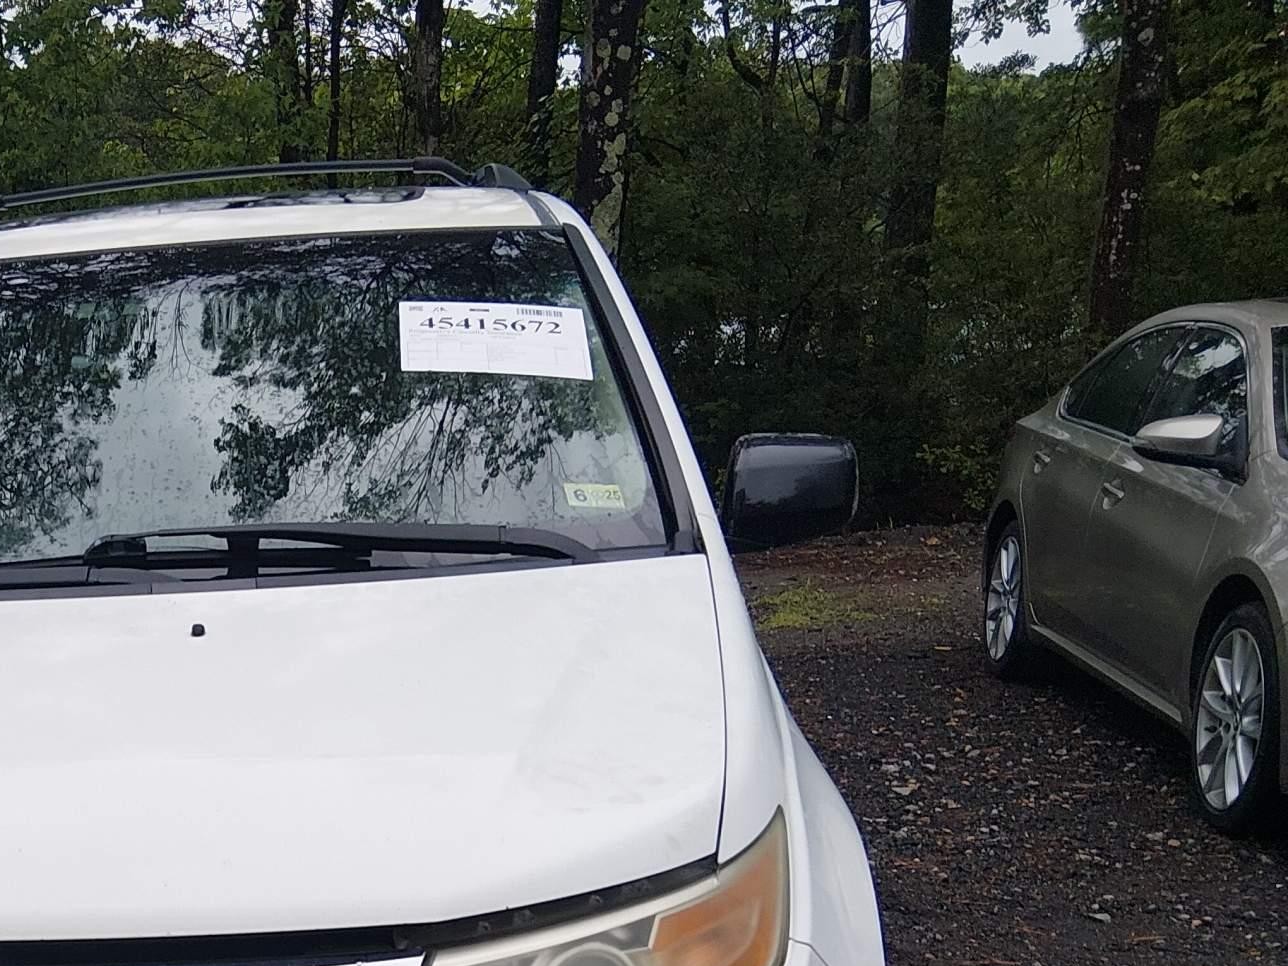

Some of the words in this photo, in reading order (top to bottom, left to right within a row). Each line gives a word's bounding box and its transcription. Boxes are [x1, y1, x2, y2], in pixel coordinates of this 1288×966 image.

[419, 316, 562, 334] 45415672
[573, 488, 588, 502] 6
[605, 489, 621, 501] 25
